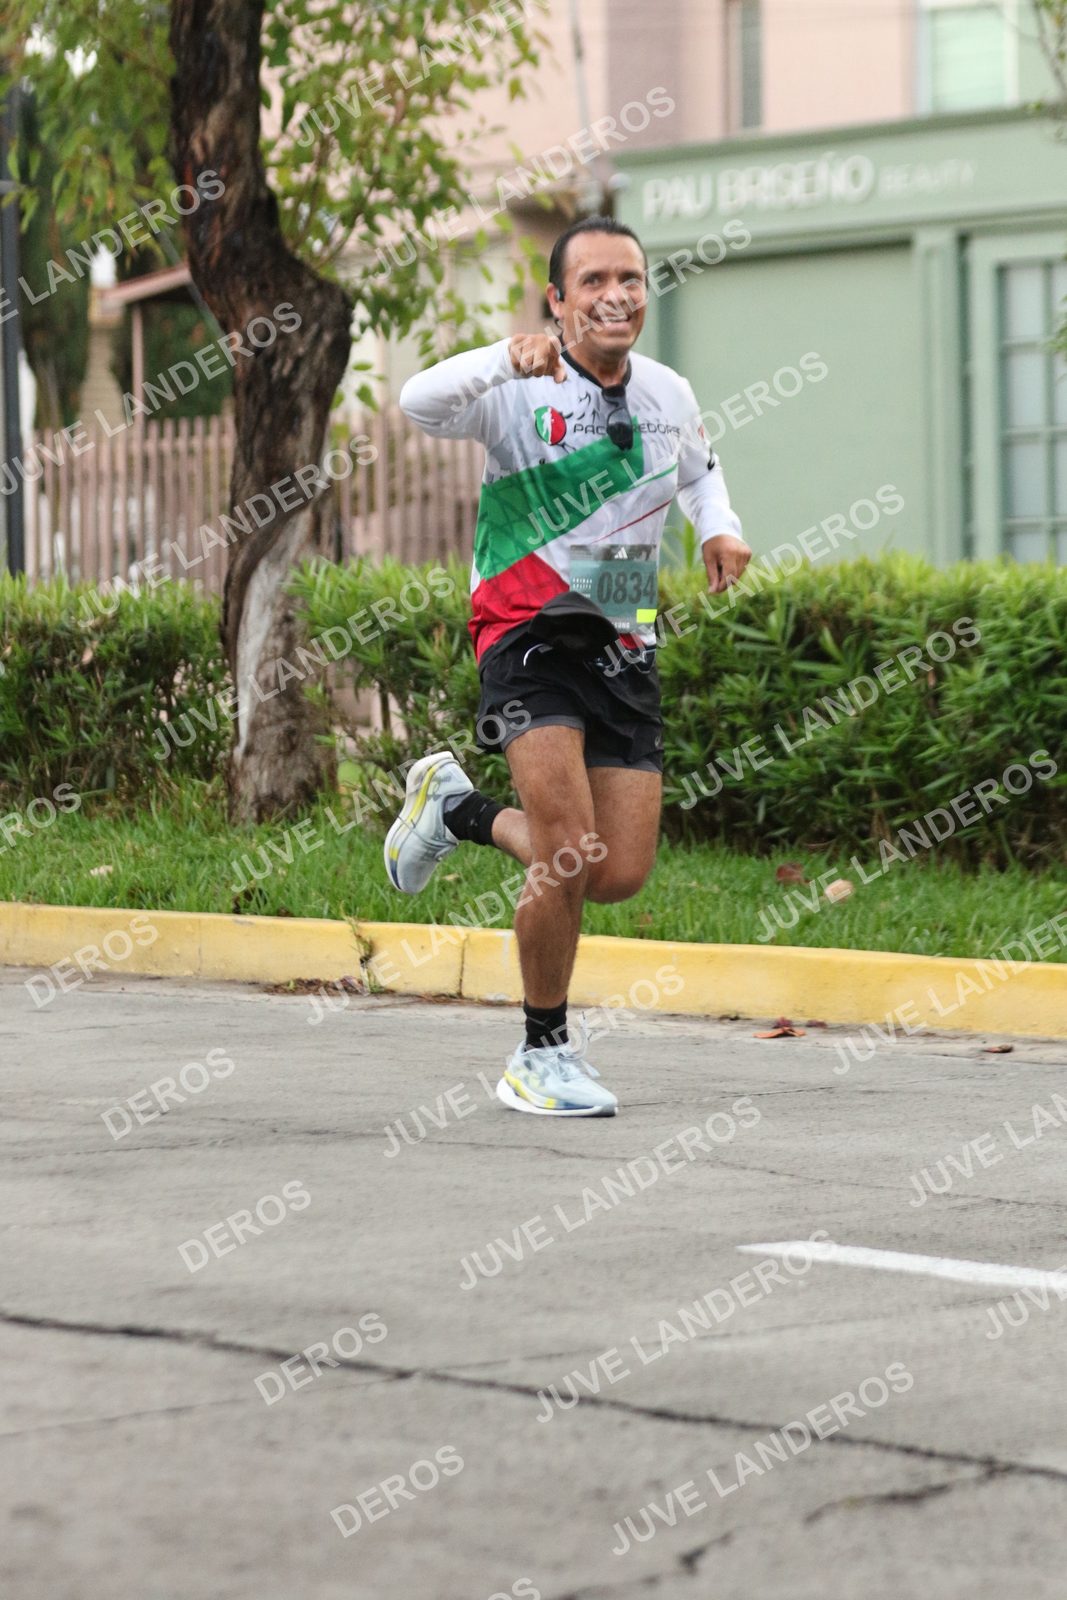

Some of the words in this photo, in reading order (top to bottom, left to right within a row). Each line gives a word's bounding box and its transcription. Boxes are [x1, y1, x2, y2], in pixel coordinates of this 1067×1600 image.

[643, 175, 711, 221] PAU
[717, 151, 875, 213] BRISEÑO
[597, 571, 656, 605] 0834
